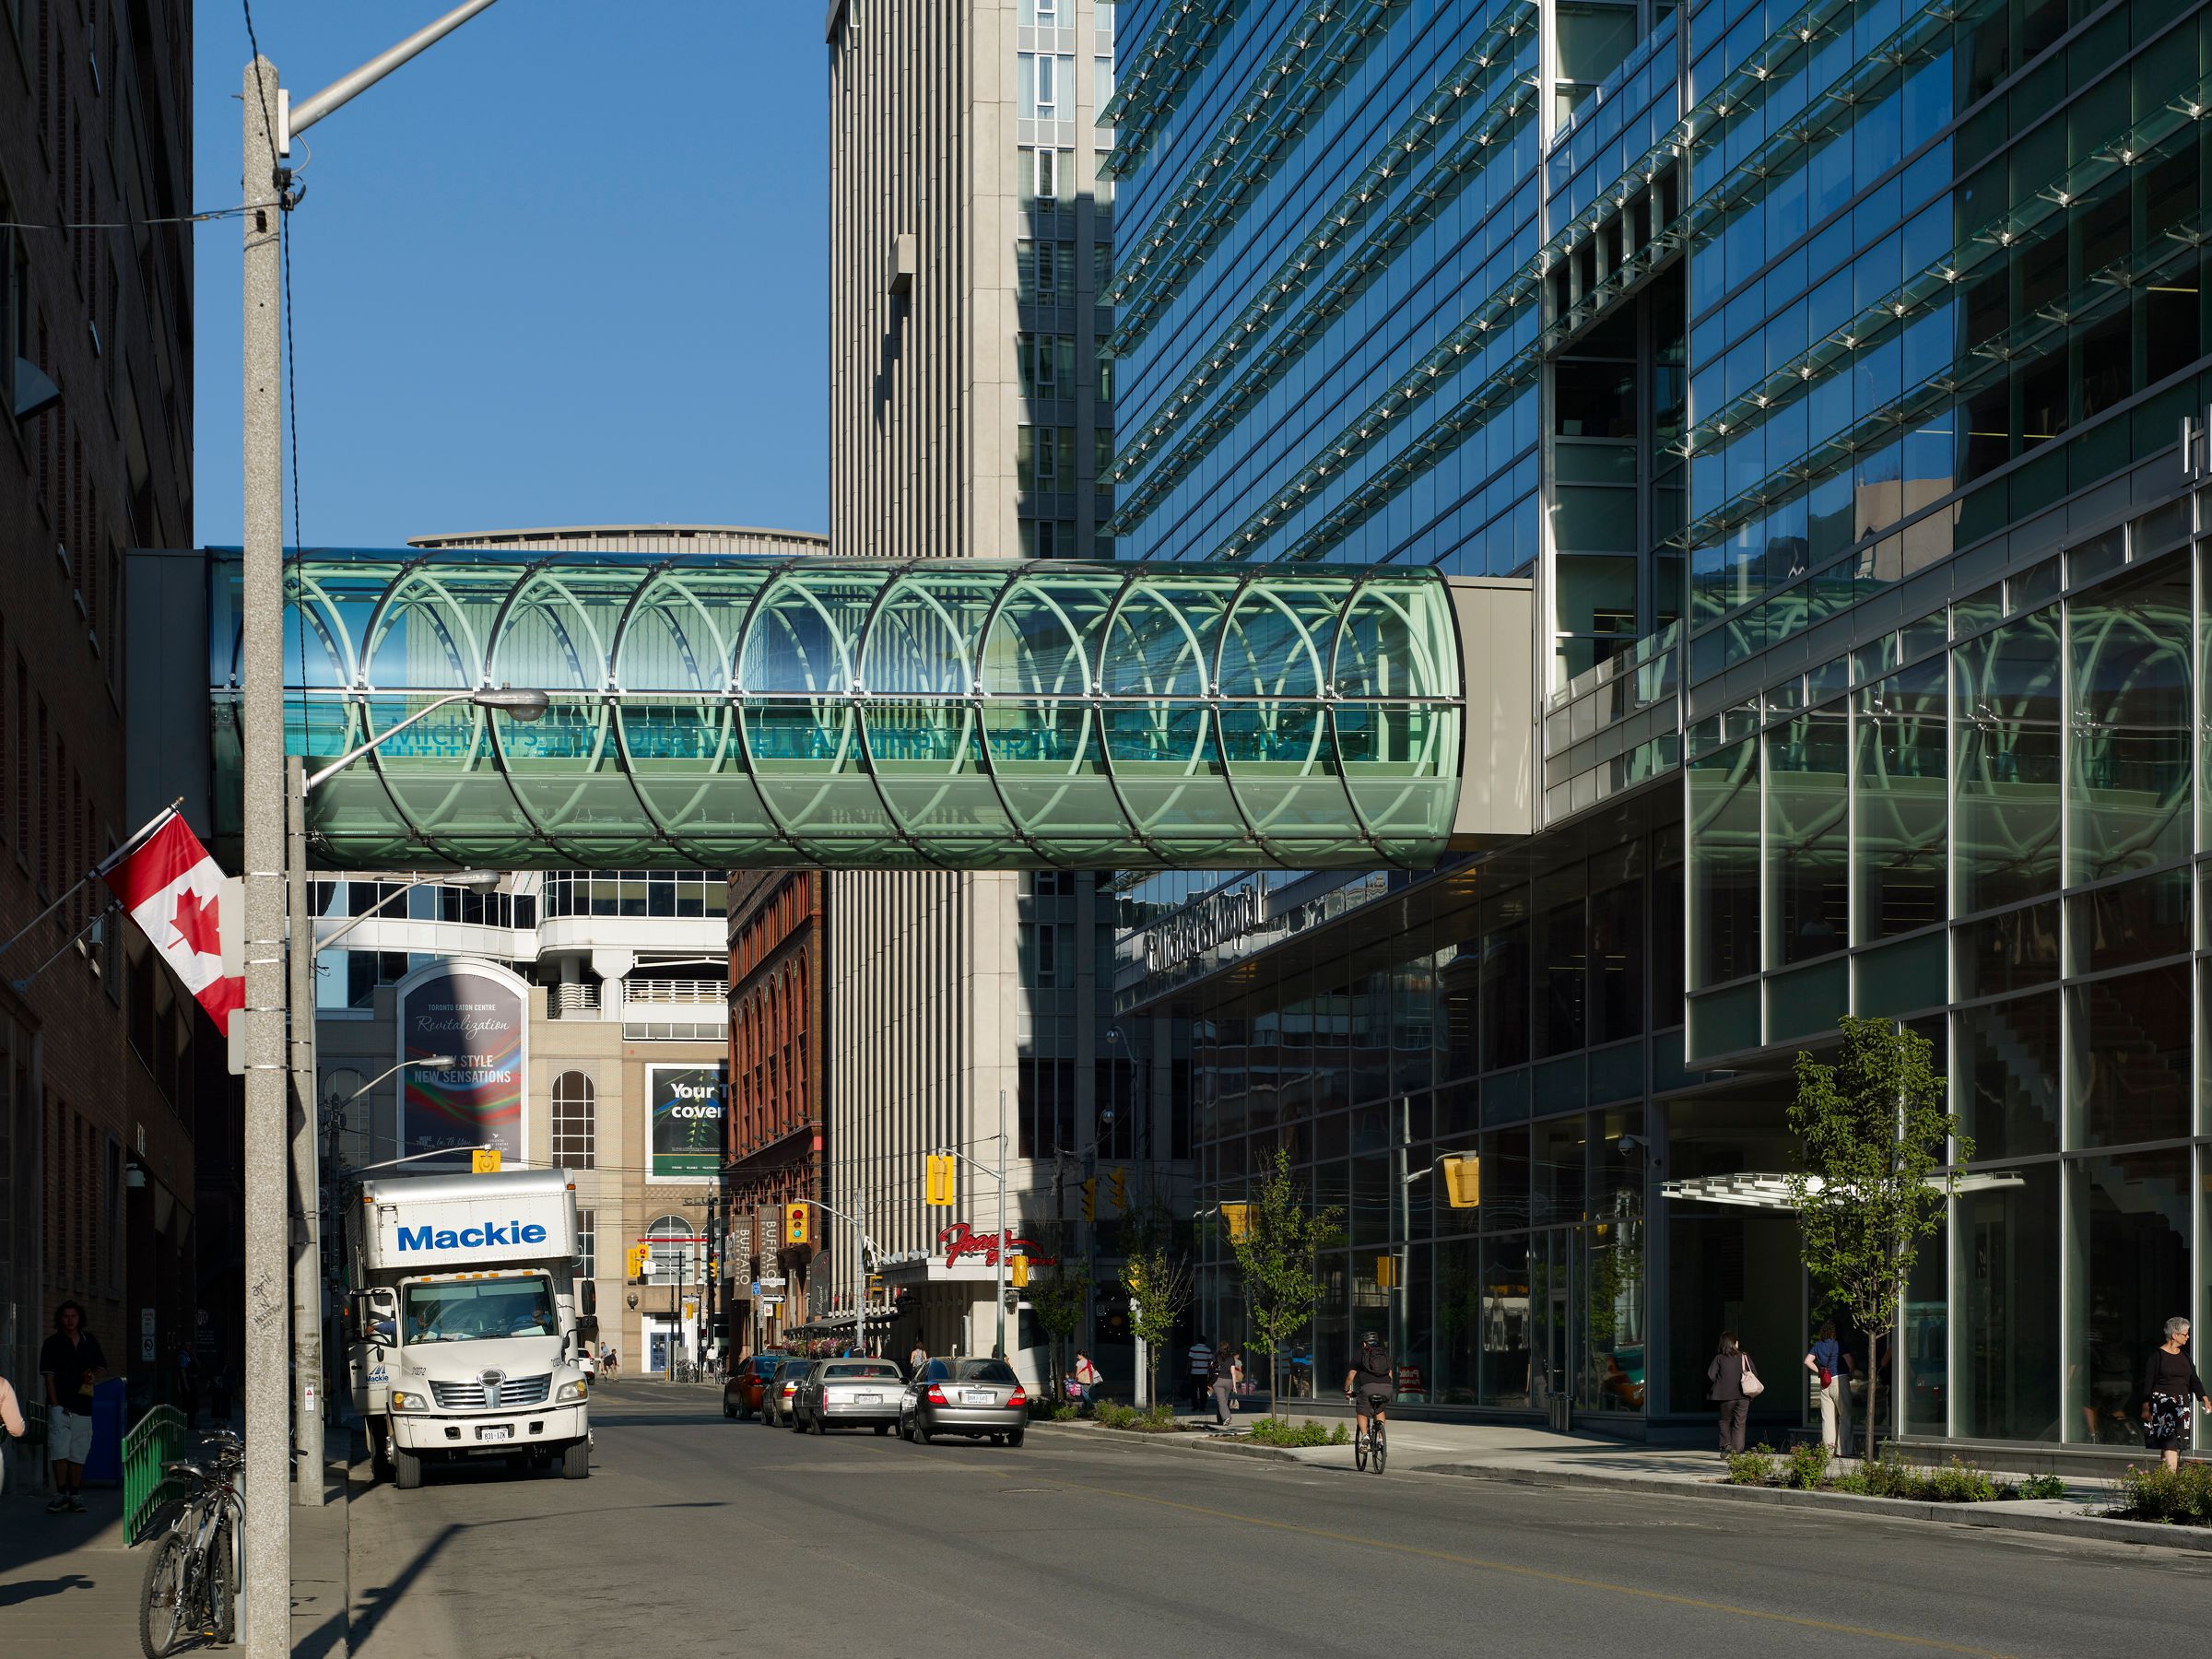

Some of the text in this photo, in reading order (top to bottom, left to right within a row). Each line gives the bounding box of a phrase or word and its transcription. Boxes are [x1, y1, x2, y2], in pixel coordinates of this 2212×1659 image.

[416, 1014, 510, 1040] Revitalization
[461, 1054, 494, 1067] STYLE
[415, 1070, 512, 1083] NEW SENSATIONS
[671, 1083, 715, 1099] Your
[397, 1219, 547, 1252] Mackie
[739, 1230, 750, 1285] BUFFALO
[766, 1221, 777, 1279] BUFFALO
